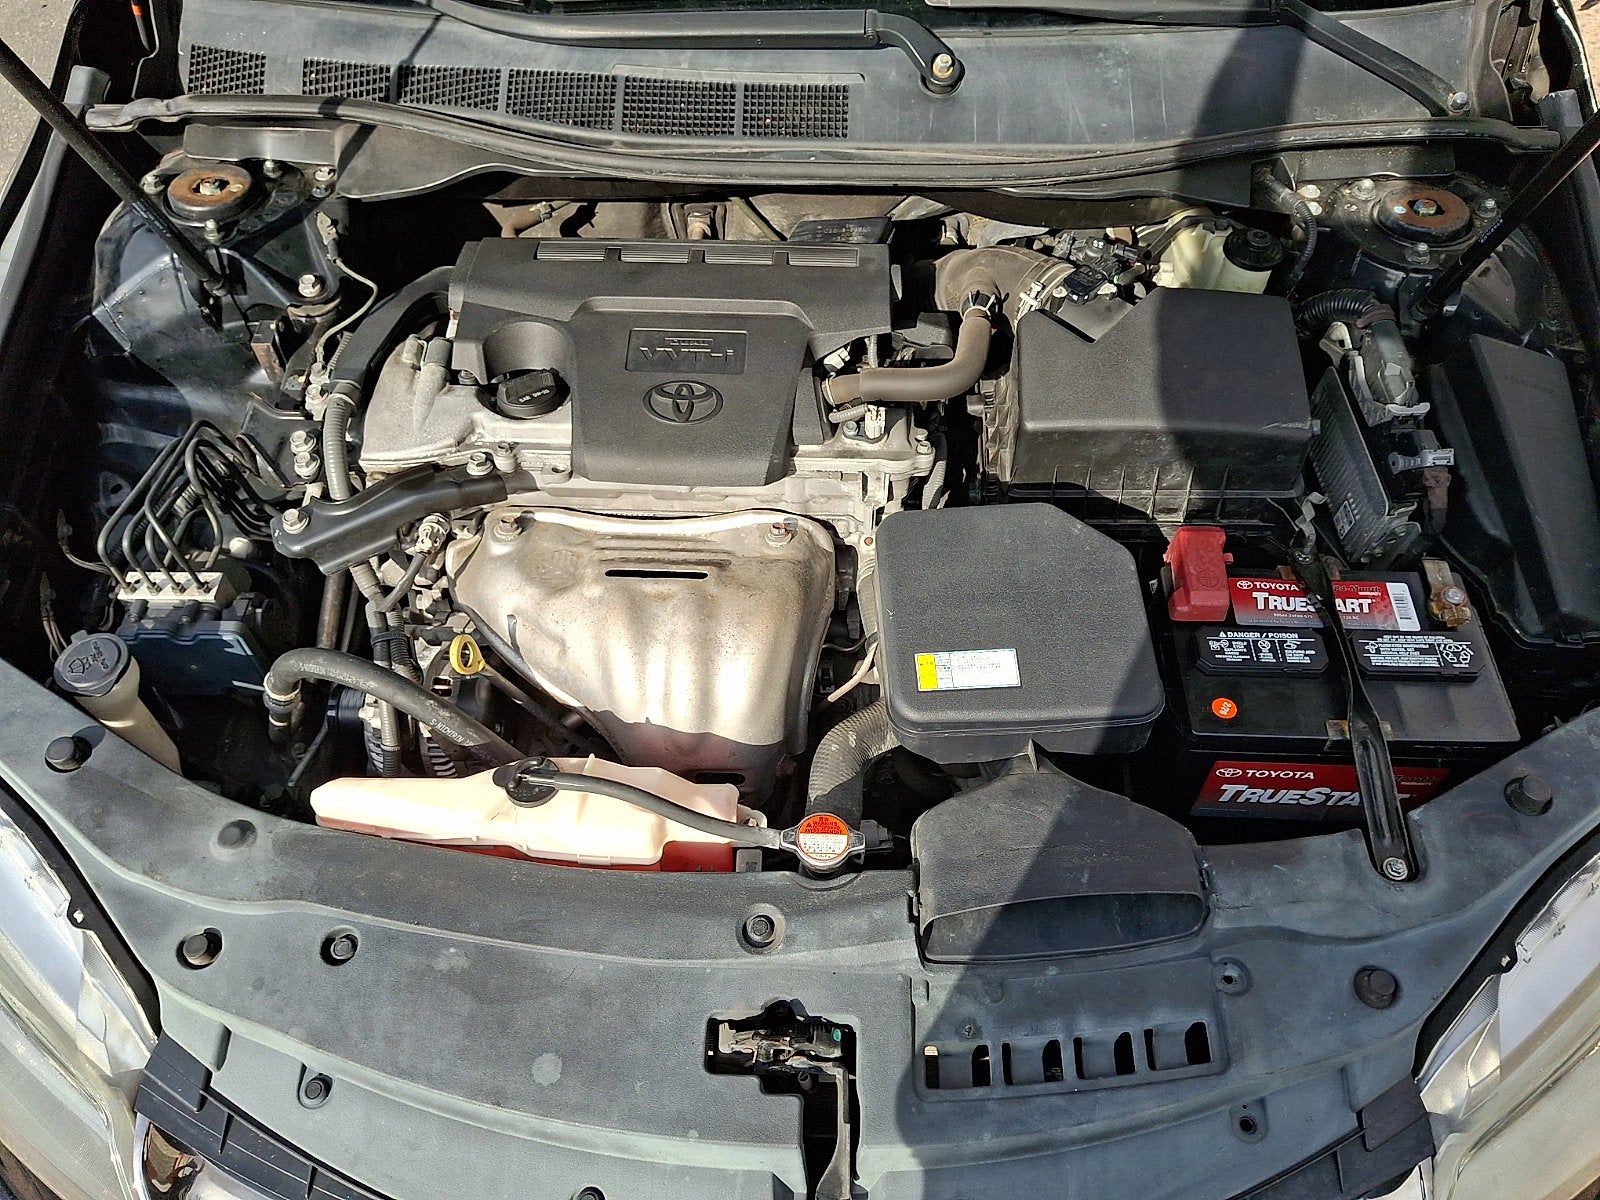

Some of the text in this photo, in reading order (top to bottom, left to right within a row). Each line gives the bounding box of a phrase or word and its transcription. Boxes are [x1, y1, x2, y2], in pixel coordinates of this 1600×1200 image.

[1253, 581, 1300, 591] TOYOTA
[1252, 591, 1372, 613] TRUEART
[1246, 769, 1315, 780] TOYOTA
[1218, 785, 1412, 806] TRUESTA
